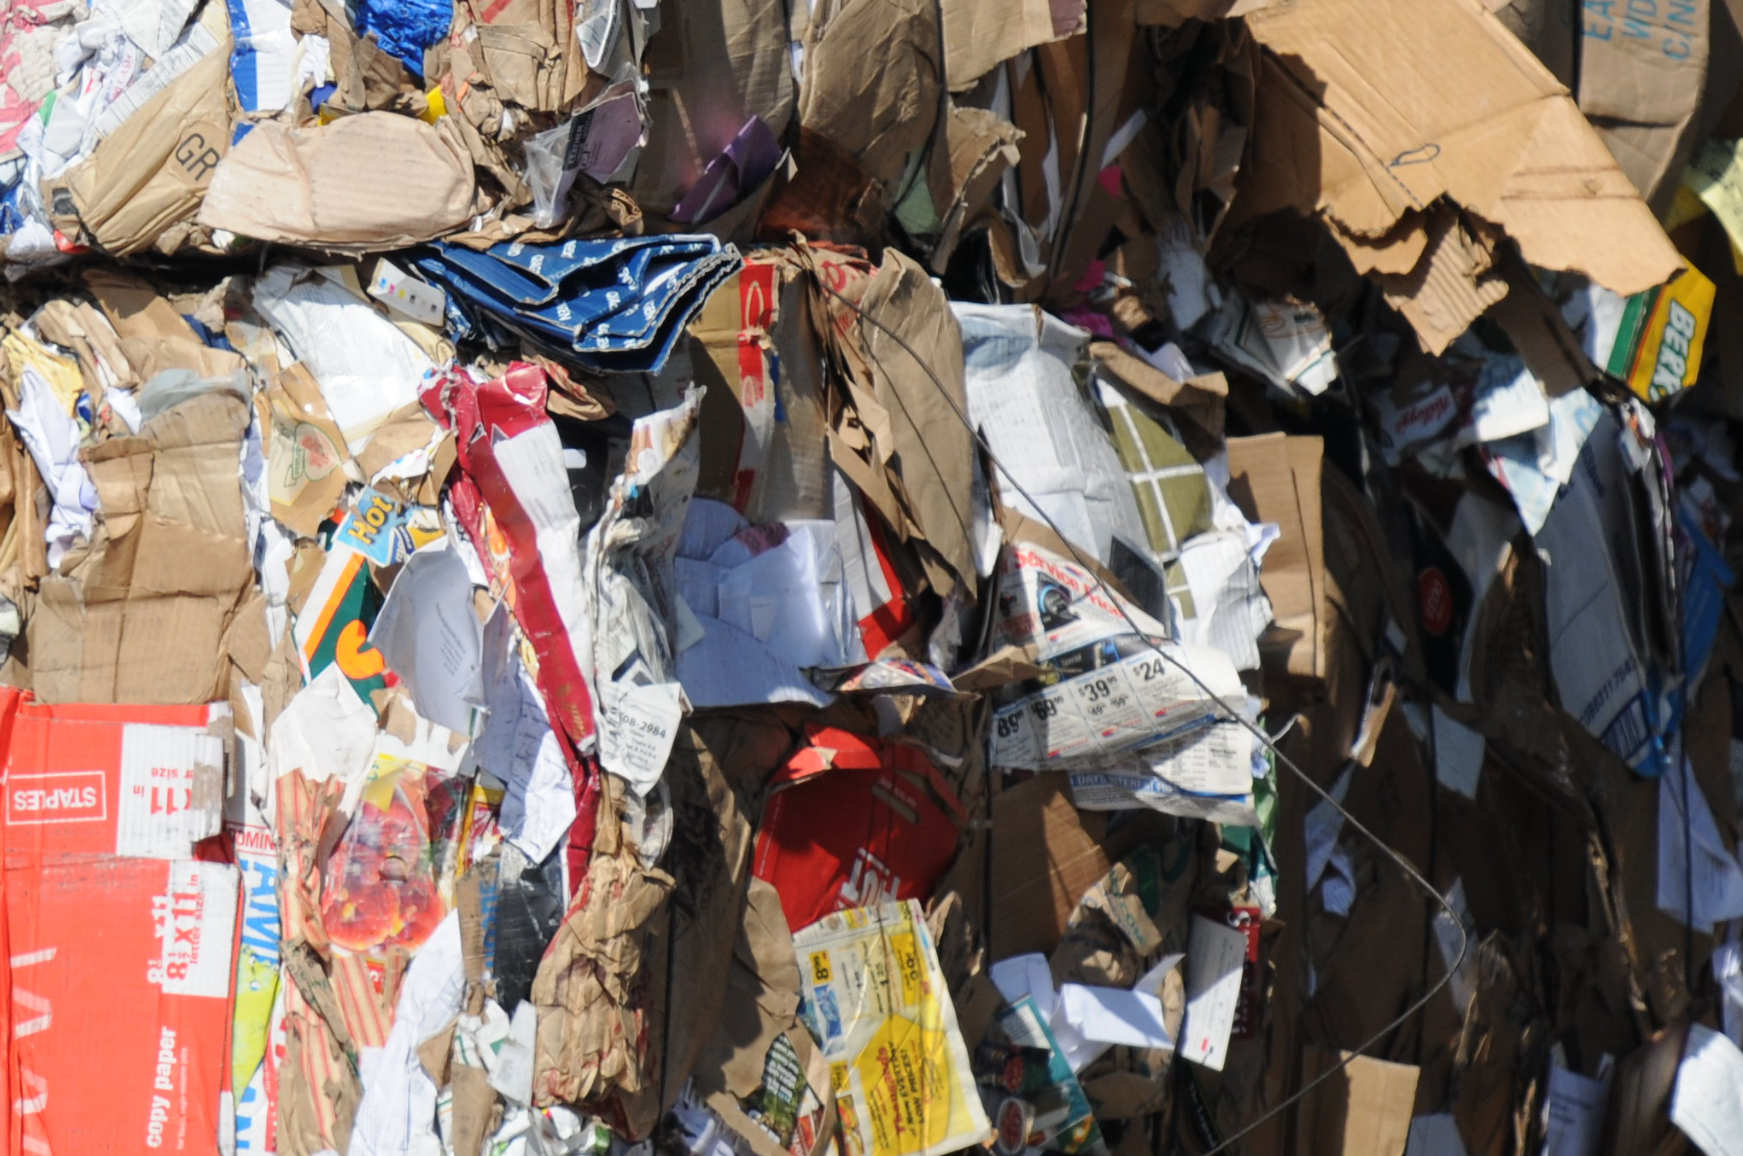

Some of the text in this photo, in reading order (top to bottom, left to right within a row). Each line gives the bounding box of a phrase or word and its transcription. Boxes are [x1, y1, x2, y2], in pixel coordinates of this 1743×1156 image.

[175, 133, 220, 181] GR
[347, 495, 393, 545] Hot
[1014, 547, 1086, 591] Service
[151, 767, 181, 778] size
[14, 787, 97, 811] STAPLES
[133, 786, 145, 797] in
[172, 892, 198, 920] 11
[188, 874, 199, 888] in
[195, 893, 206, 921] size
[146, 1027, 178, 1149] copy paper
[911, 1094, 925, 1124] LOW
